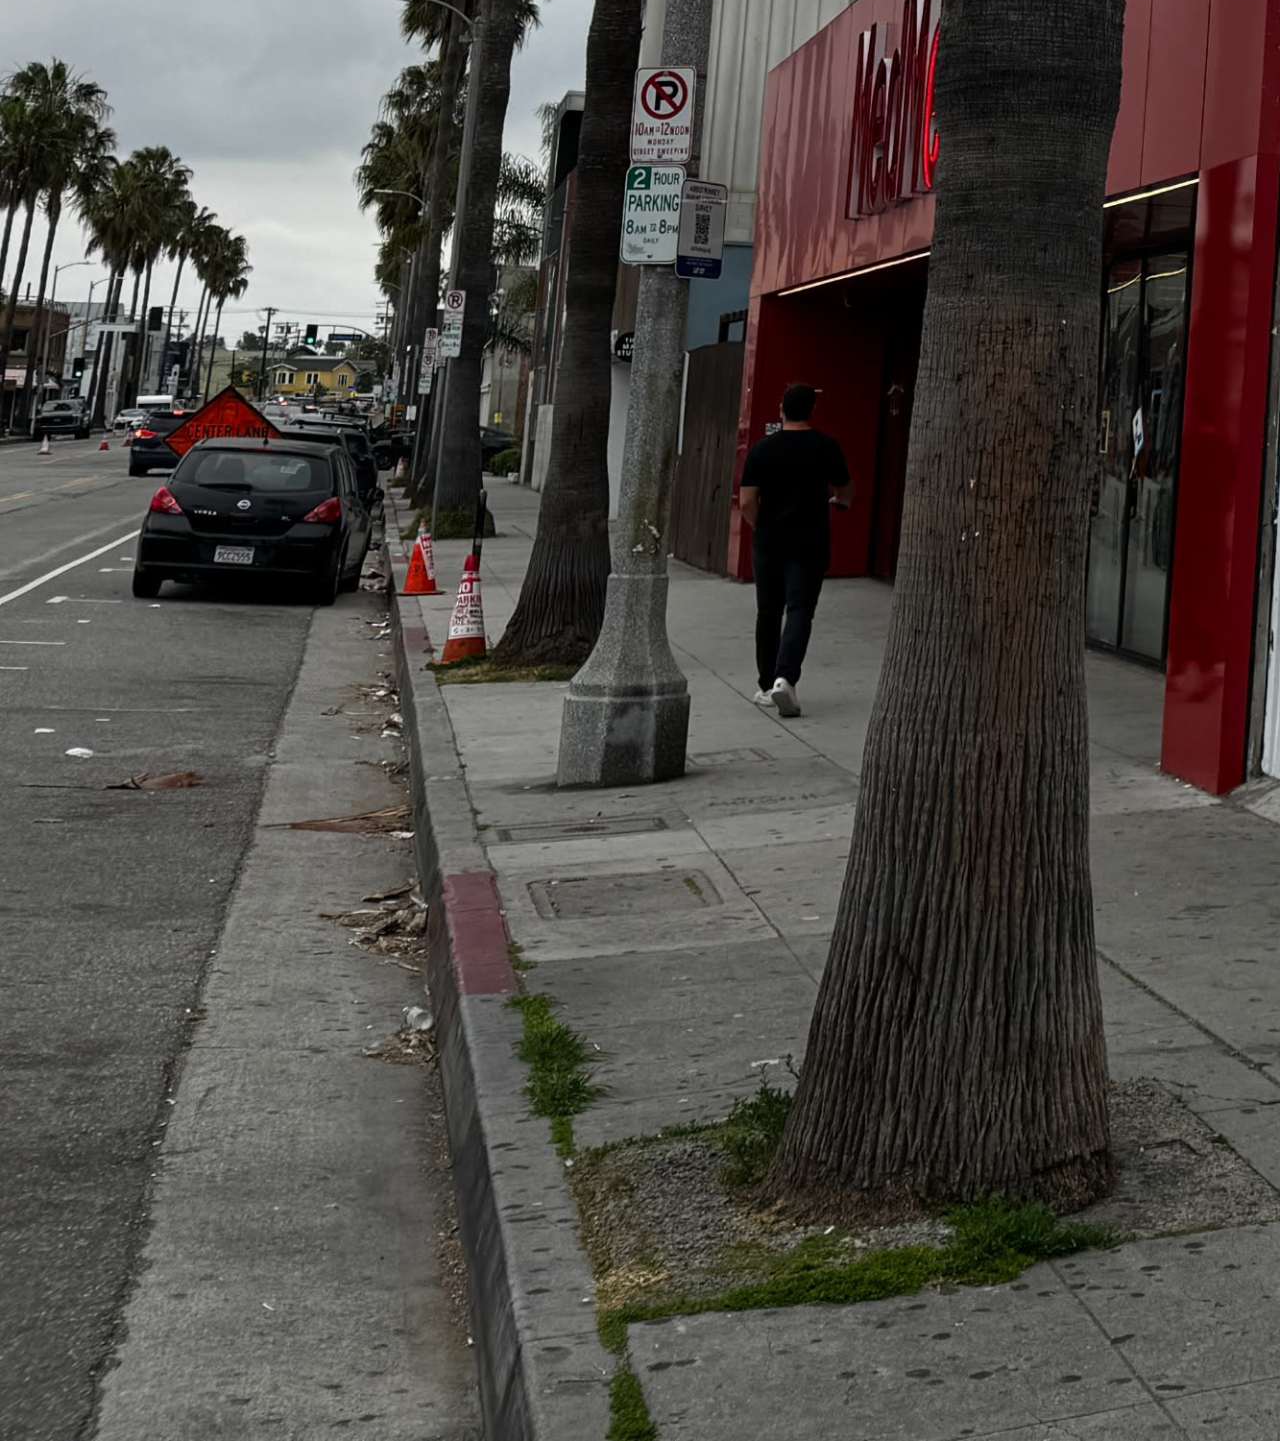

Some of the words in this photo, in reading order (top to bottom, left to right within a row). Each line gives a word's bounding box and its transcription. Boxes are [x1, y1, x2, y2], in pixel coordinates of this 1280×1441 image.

[633, 168, 647, 189] 2
[653, 171, 680, 186] HOUR
[628, 194, 680, 213] PARKING
[186, 423, 232, 439] CENTER
